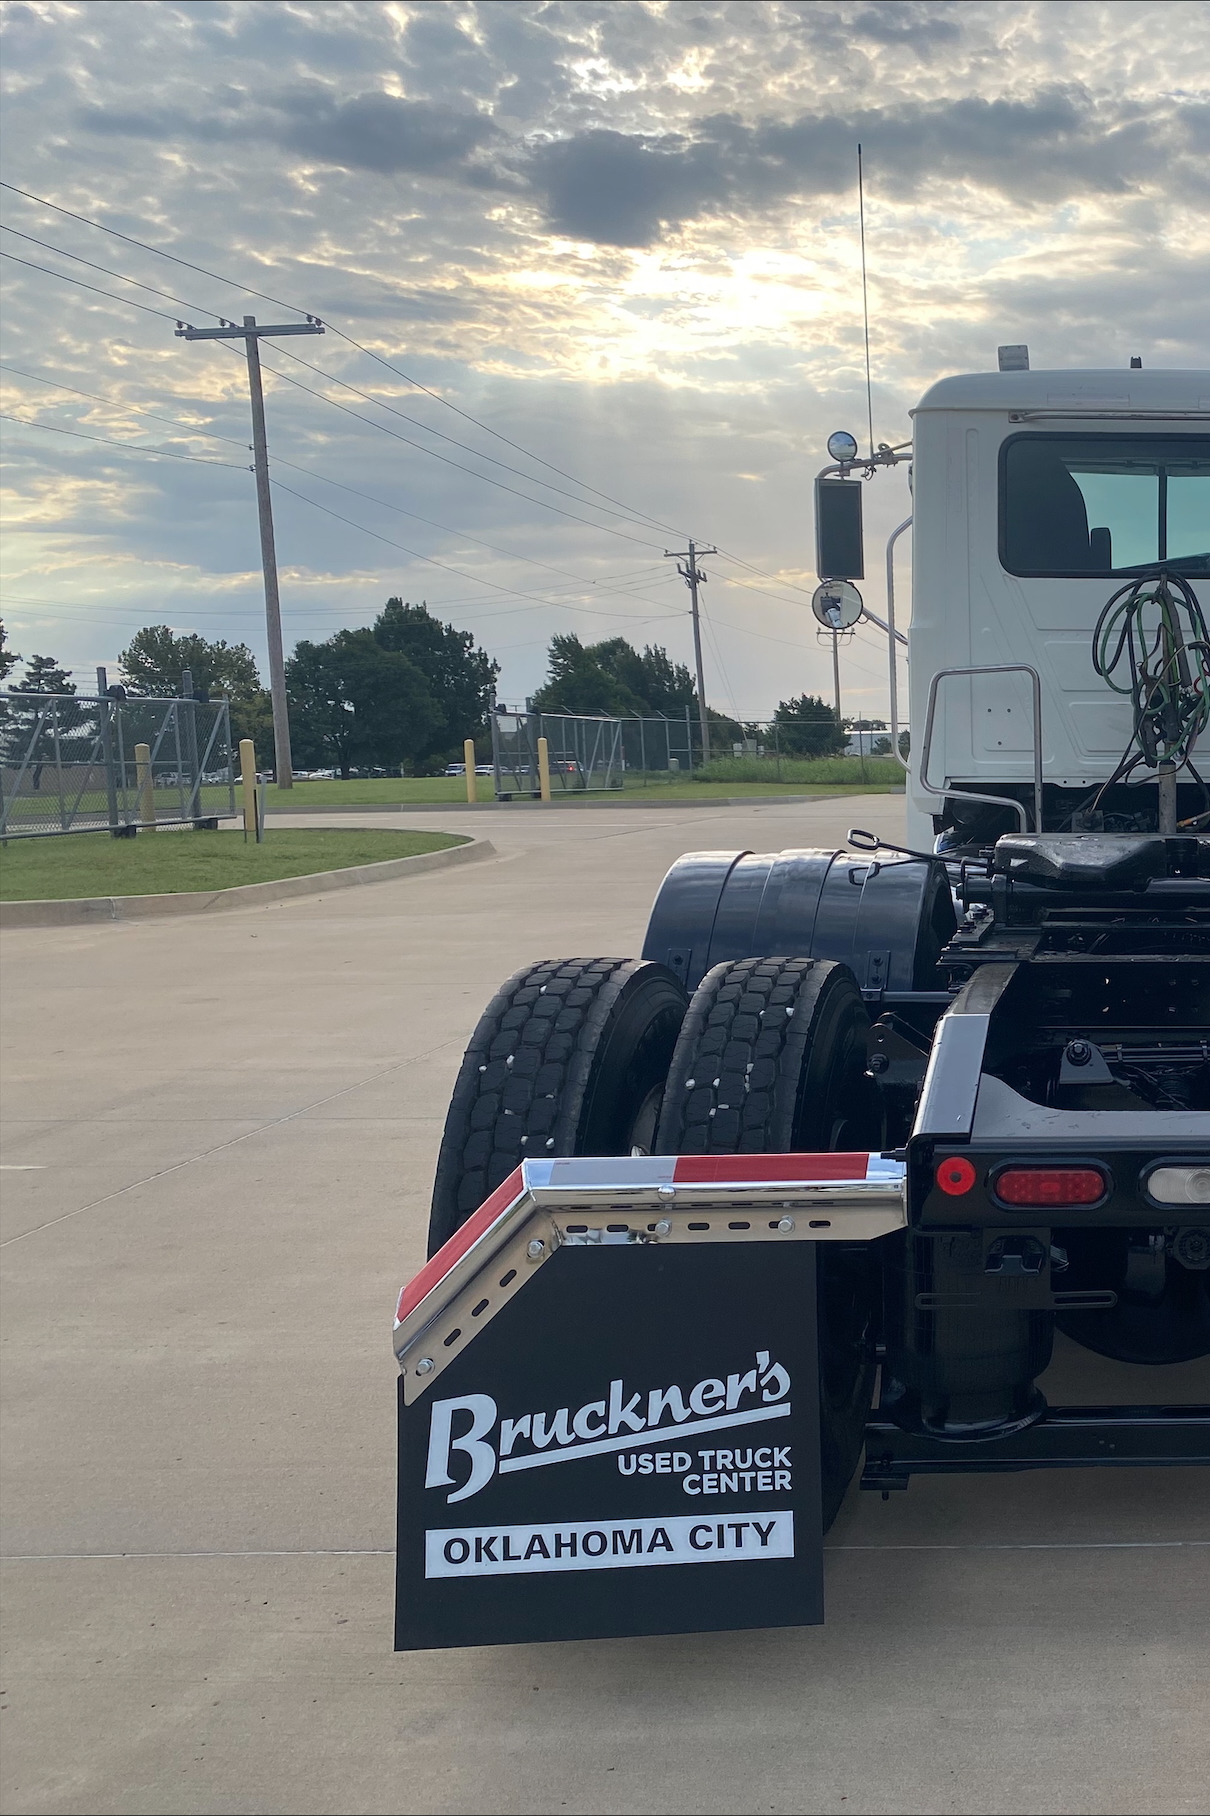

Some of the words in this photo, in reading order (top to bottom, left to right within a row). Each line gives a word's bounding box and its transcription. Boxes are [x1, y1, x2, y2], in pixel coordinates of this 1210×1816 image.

[424, 1350, 791, 1504] Bruckner's
[618, 1451, 691, 1476] USED
[698, 1446, 792, 1470] TRUCK
[682, 1470, 793, 1495] CENTER
[443, 1526, 675, 1565] OKLAHOMA
[688, 1520, 776, 1550] CITY
